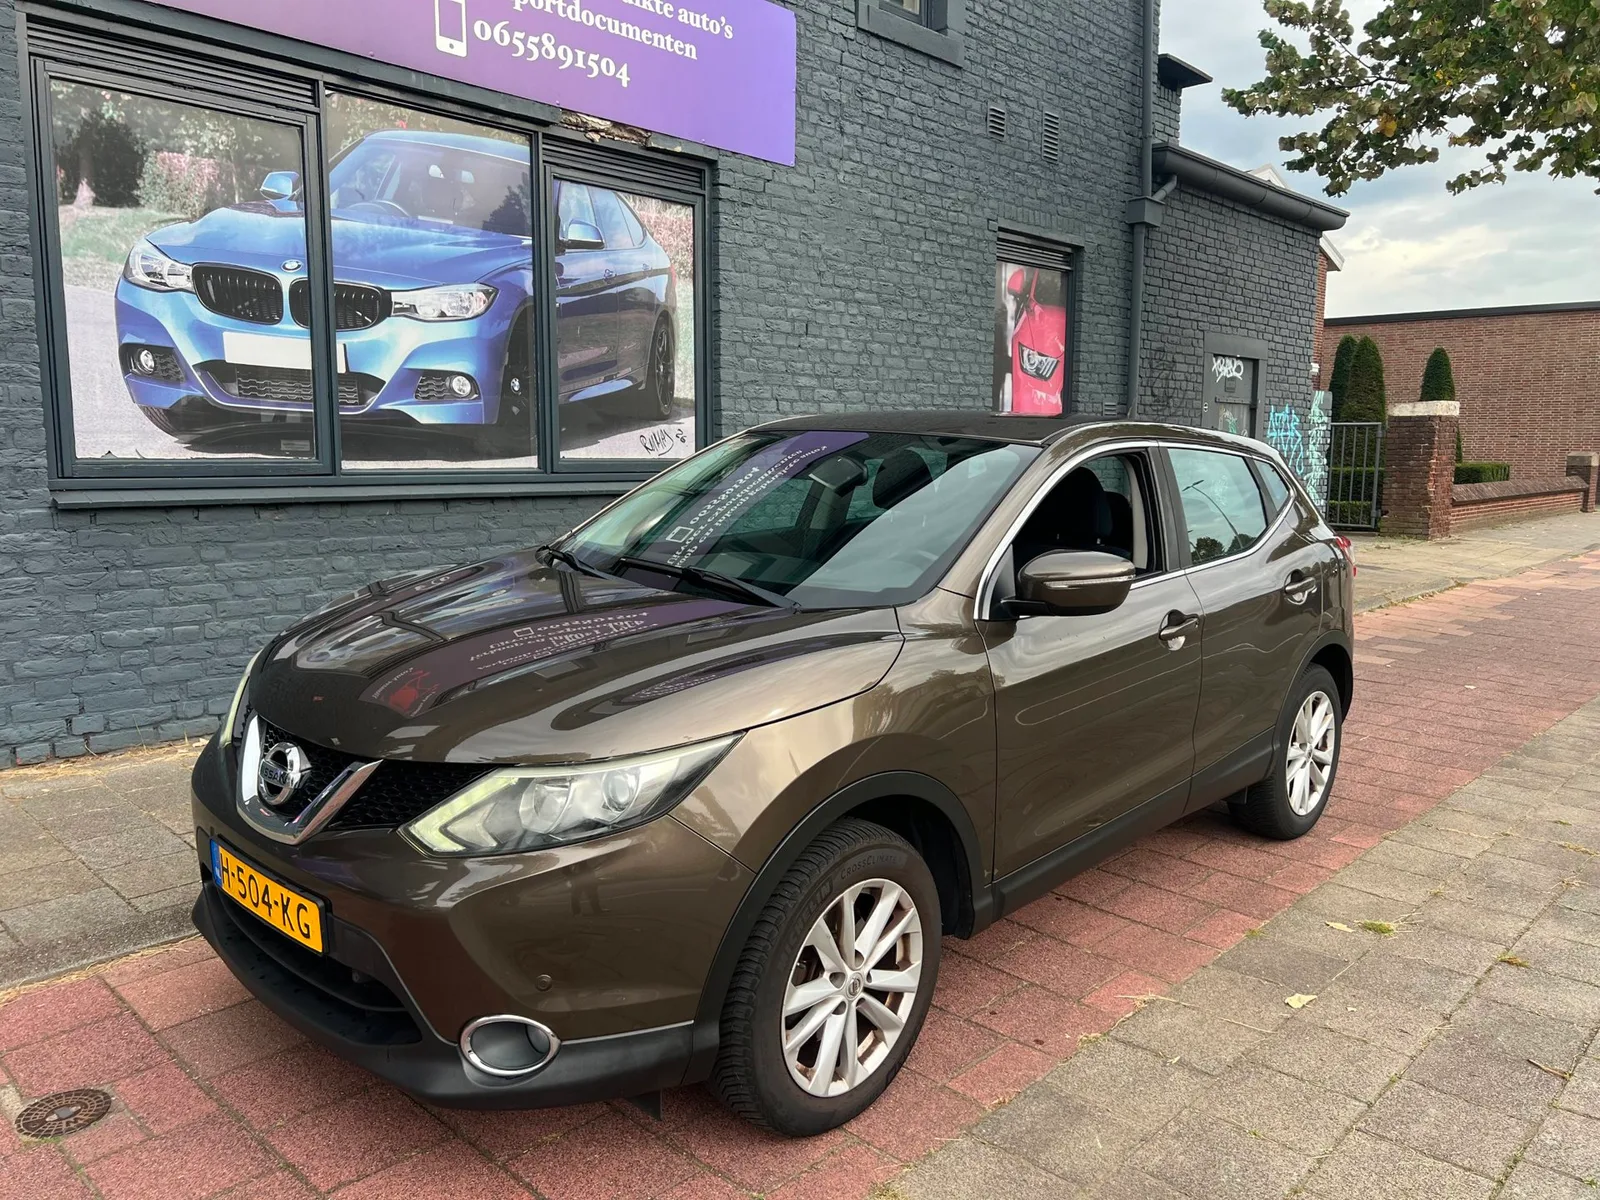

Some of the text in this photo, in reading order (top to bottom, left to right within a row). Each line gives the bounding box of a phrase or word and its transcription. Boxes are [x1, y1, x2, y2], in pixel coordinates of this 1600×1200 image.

[473, 20, 631, 88] 0655891504
[678, 8, 734, 40] auto's
[220, 852, 311, 940] H-504-KG
